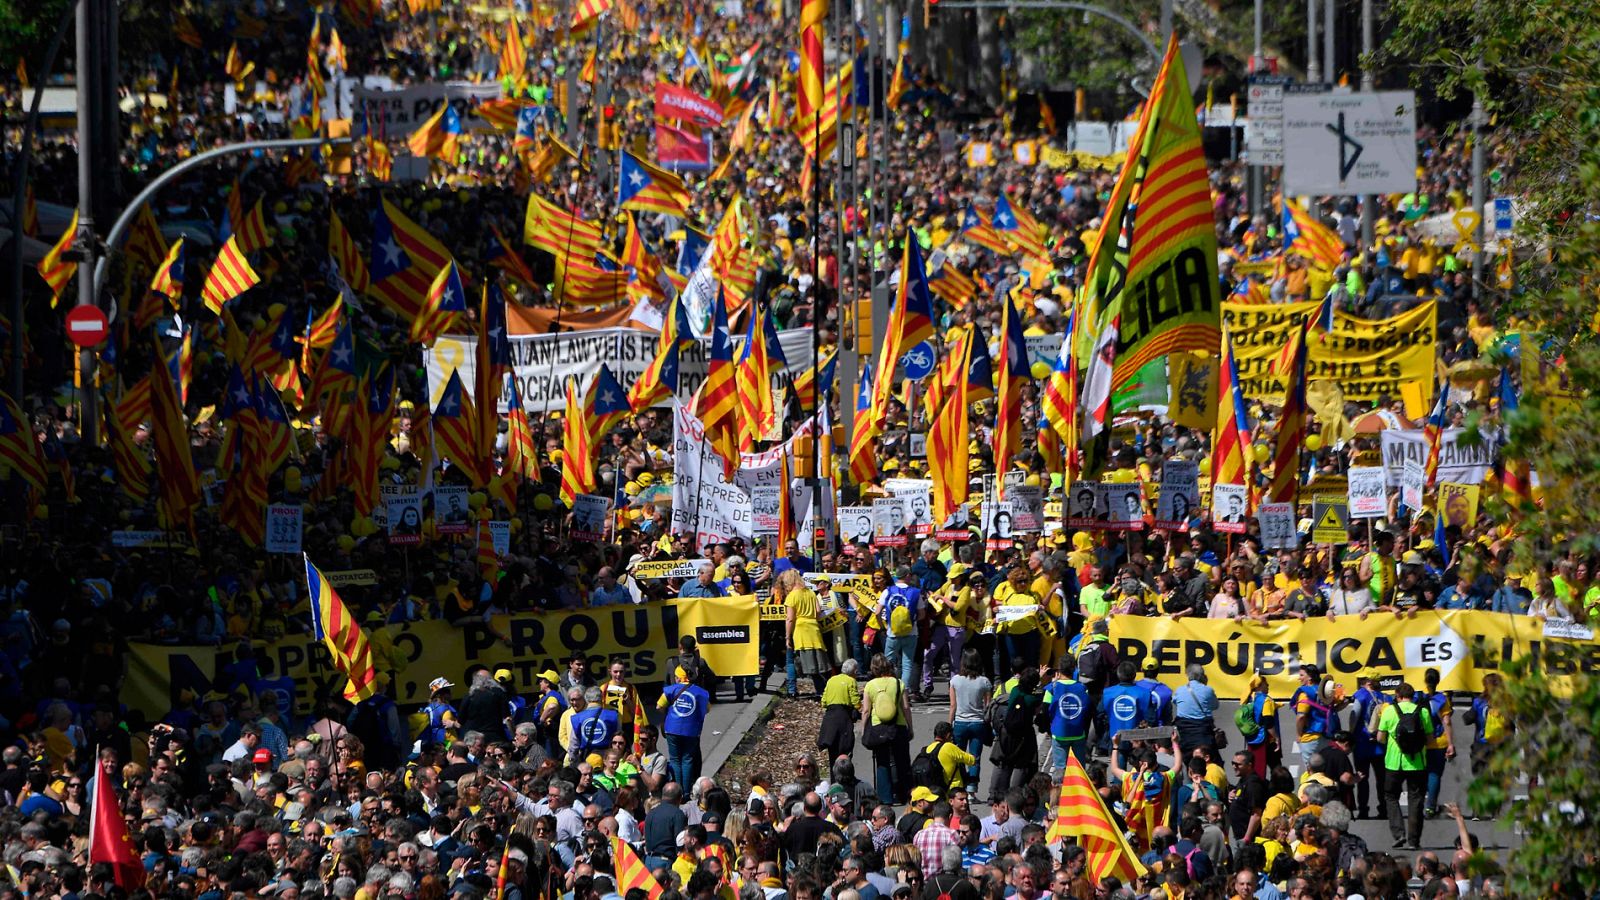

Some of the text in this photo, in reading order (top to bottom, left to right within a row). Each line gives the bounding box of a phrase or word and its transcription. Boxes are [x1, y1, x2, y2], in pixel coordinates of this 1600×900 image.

[464, 604, 679, 661] PROU!
[702, 629, 745, 640] assemblea
[1117, 631, 1401, 676] REPÚBLICA
[1421, 638, 1452, 663] ÉS
